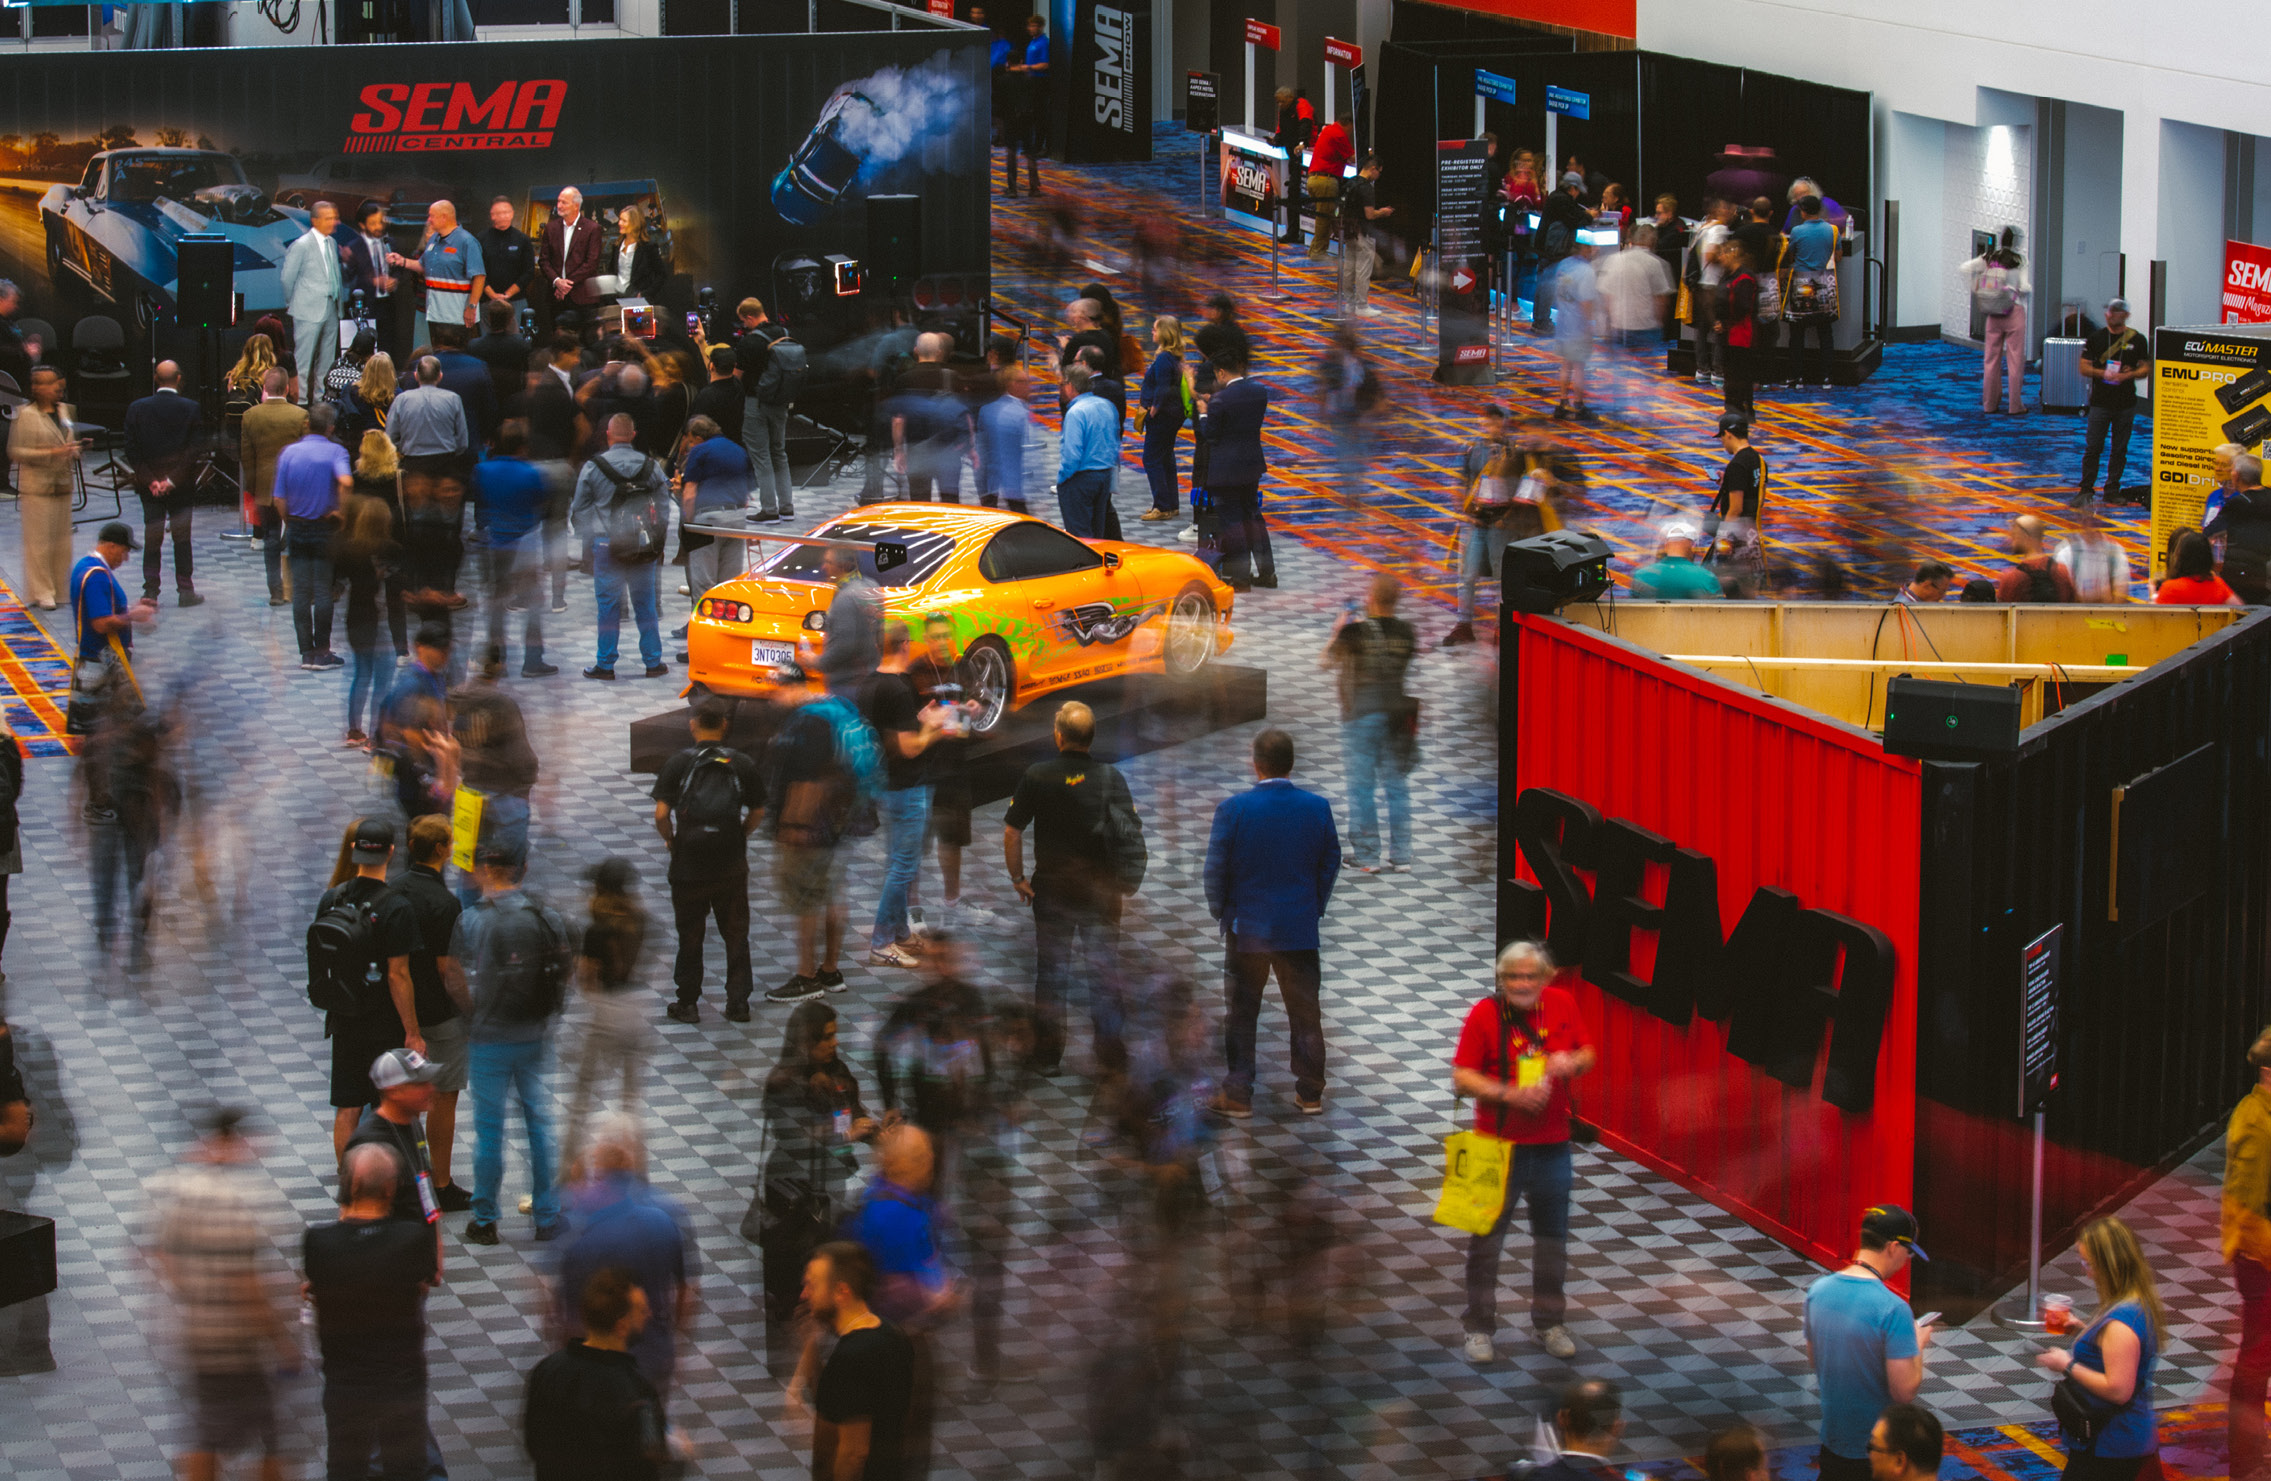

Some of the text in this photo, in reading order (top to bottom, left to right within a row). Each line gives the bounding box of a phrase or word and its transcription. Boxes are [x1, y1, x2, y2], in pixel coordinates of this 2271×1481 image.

[1327, 45, 1352, 60] INFORMATION
[1094, 4, 1123, 129] SEMA
[351, 79, 568, 133] SEMA
[401, 135, 545, 149] CENTRAL
[1236, 166, 1267, 193] SEMA
[2228, 260, 2271, 293] SEM
[1460, 348, 1487, 357] SEMA
[2183, 352, 2257, 364] MOTORSPORT ELECTRONICS
[2162, 386, 2185, 394] Control
[2160, 451, 2216, 463] Gasoline Direc
[2176, 461, 2200, 469] Diesel
[1498, 787, 1896, 1114] SEMA
